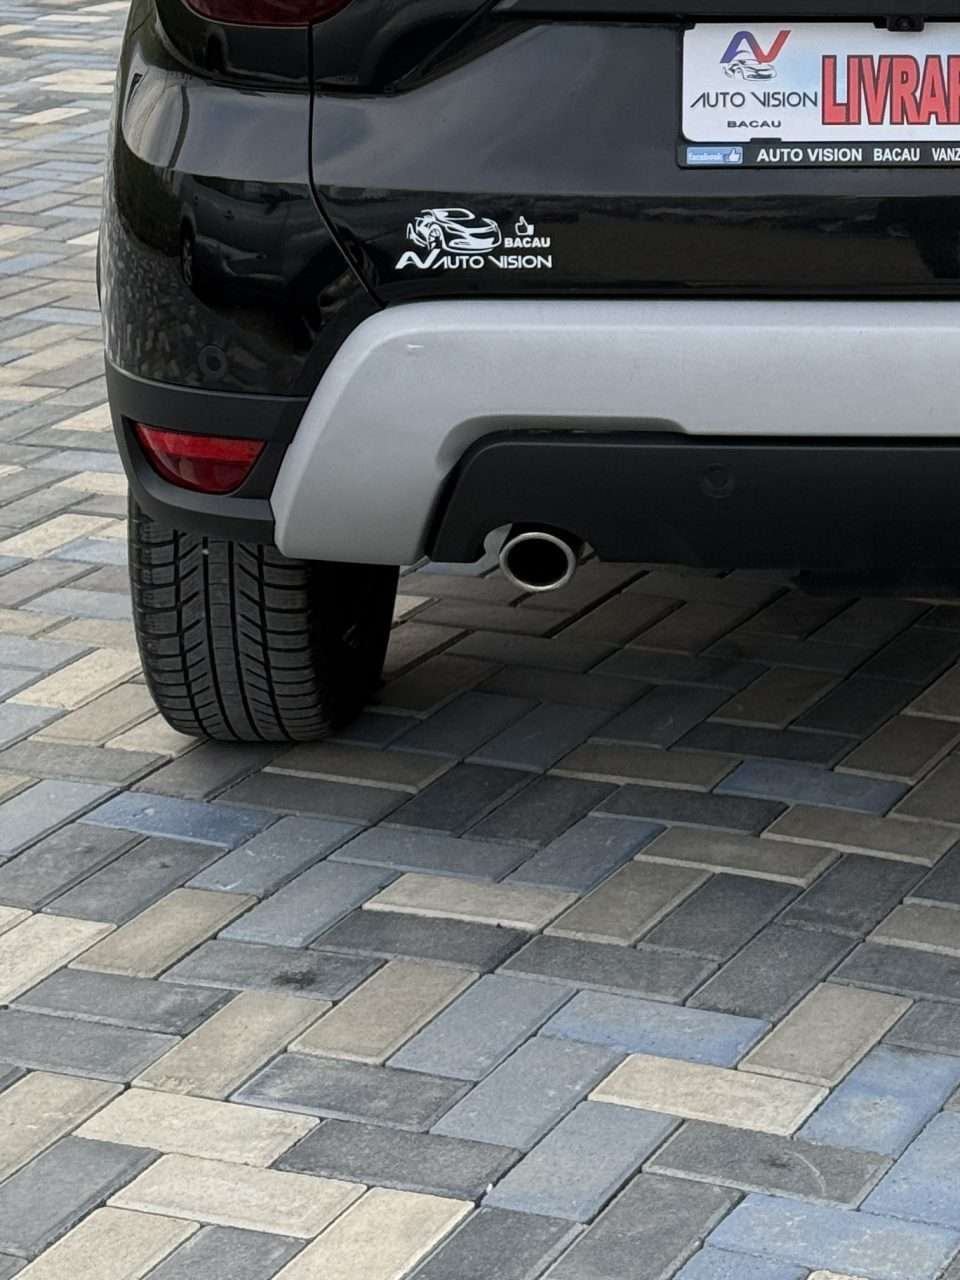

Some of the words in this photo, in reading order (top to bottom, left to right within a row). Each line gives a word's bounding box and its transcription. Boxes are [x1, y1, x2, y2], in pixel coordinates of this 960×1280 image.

[690, 91, 746, 108] AUTO
[750, 91, 818, 108] VISION
[727, 120, 782, 128] BACAU
[756, 148, 803, 162] AUTO
[807, 148, 862, 162] VISION
[873, 147, 920, 162] BACAU
[504, 237, 551, 248] BACAU
[432, 255, 485, 269] AUTO
[488, 255, 552, 269] VISION
